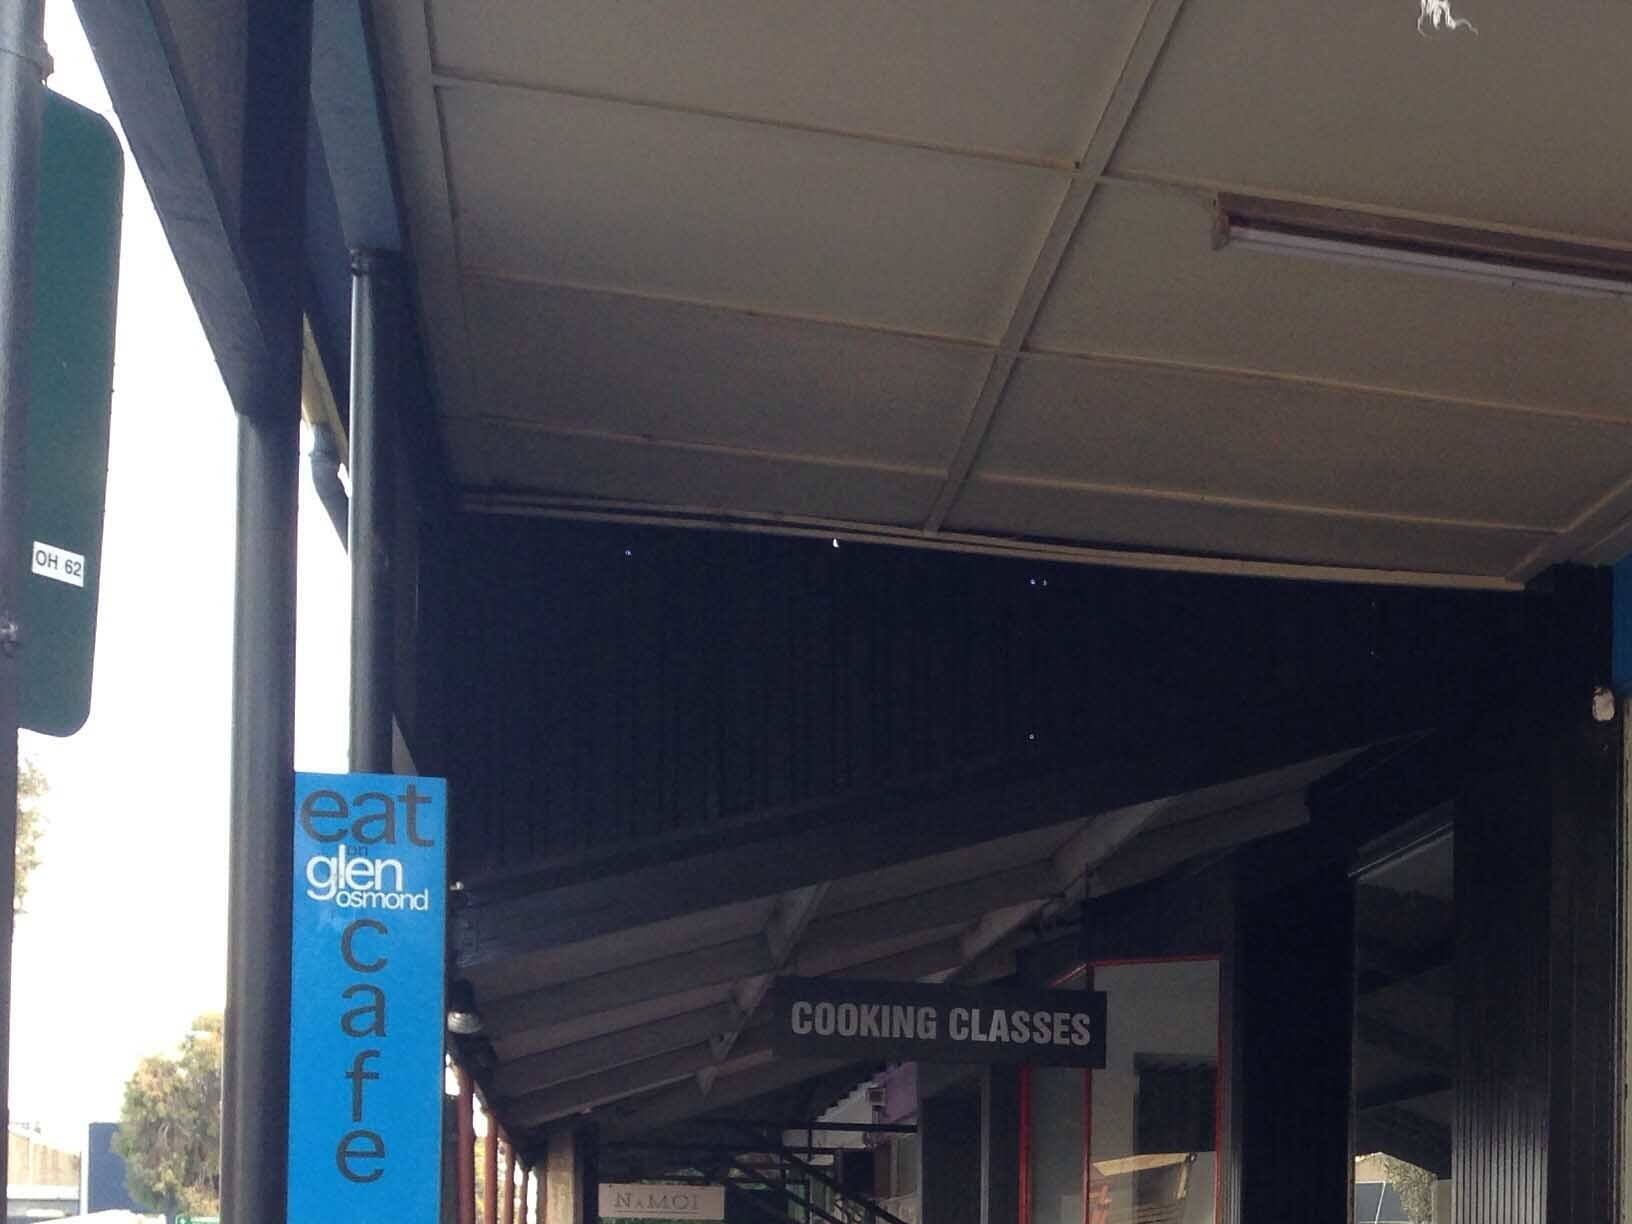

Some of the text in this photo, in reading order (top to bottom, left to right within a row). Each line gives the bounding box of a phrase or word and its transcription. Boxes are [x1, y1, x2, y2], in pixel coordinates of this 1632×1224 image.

[35, 550, 82, 577] OH 62
[301, 784, 434, 847] eat
[306, 844, 403, 900] glen
[336, 888, 429, 911] osmond
[791, 1001, 1090, 1046] COOKING CLASSES
[335, 918, 388, 1183] cafe
